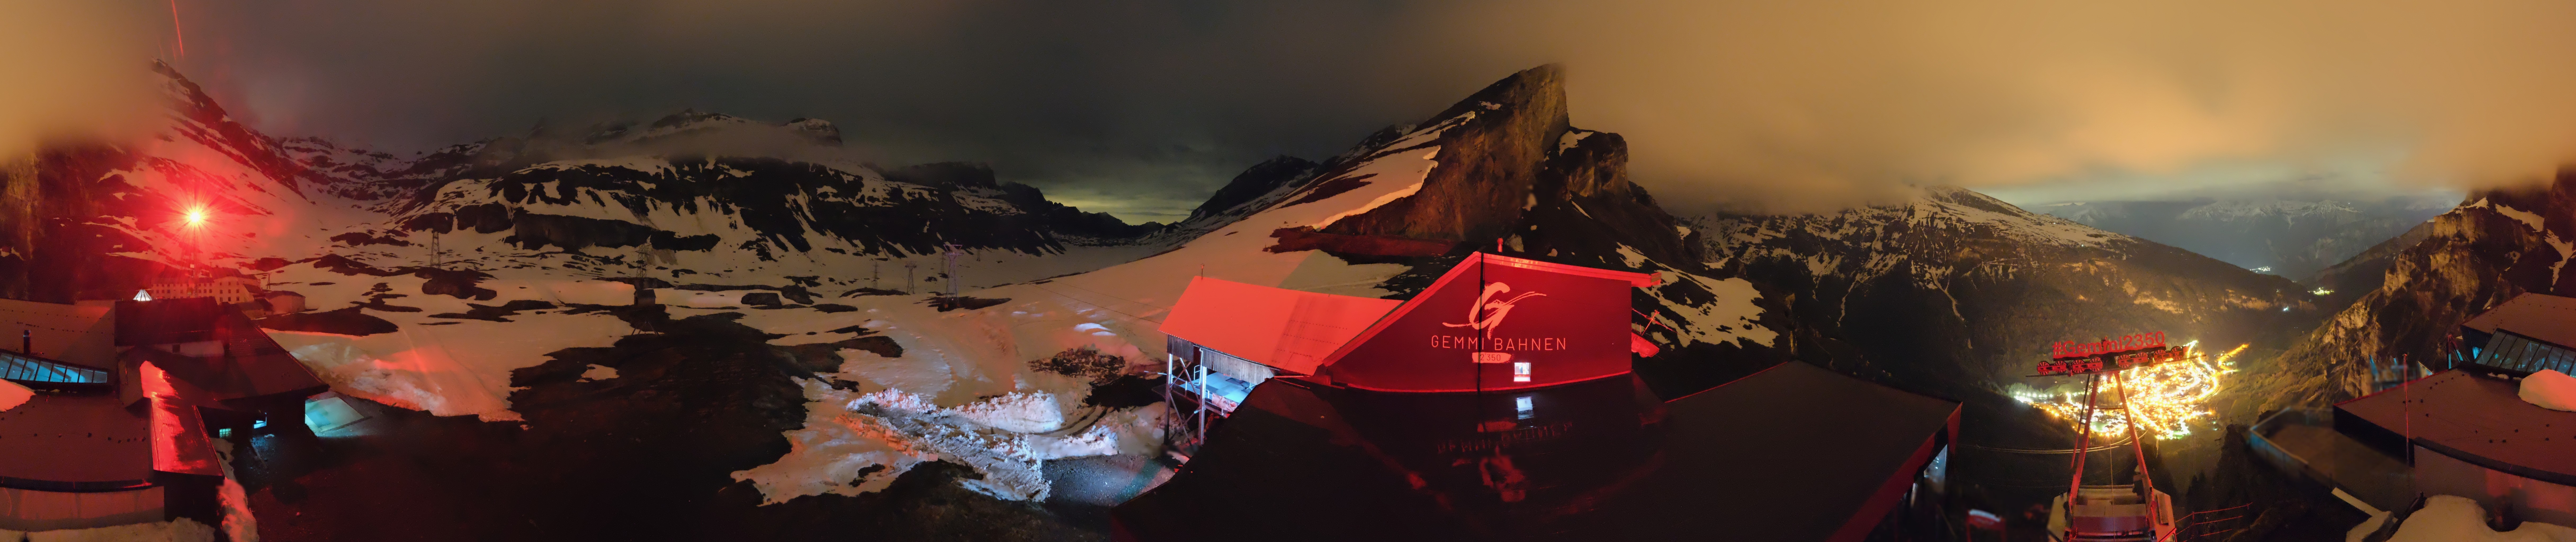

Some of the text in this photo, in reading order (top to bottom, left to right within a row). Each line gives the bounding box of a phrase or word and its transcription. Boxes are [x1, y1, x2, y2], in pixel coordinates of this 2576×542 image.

[1432, 335, 1566, 351] GEMMI BAHNEN
[2052, 331, 2165, 355] #Gemmi2350
[1480, 353, 1501, 361] 2'350
